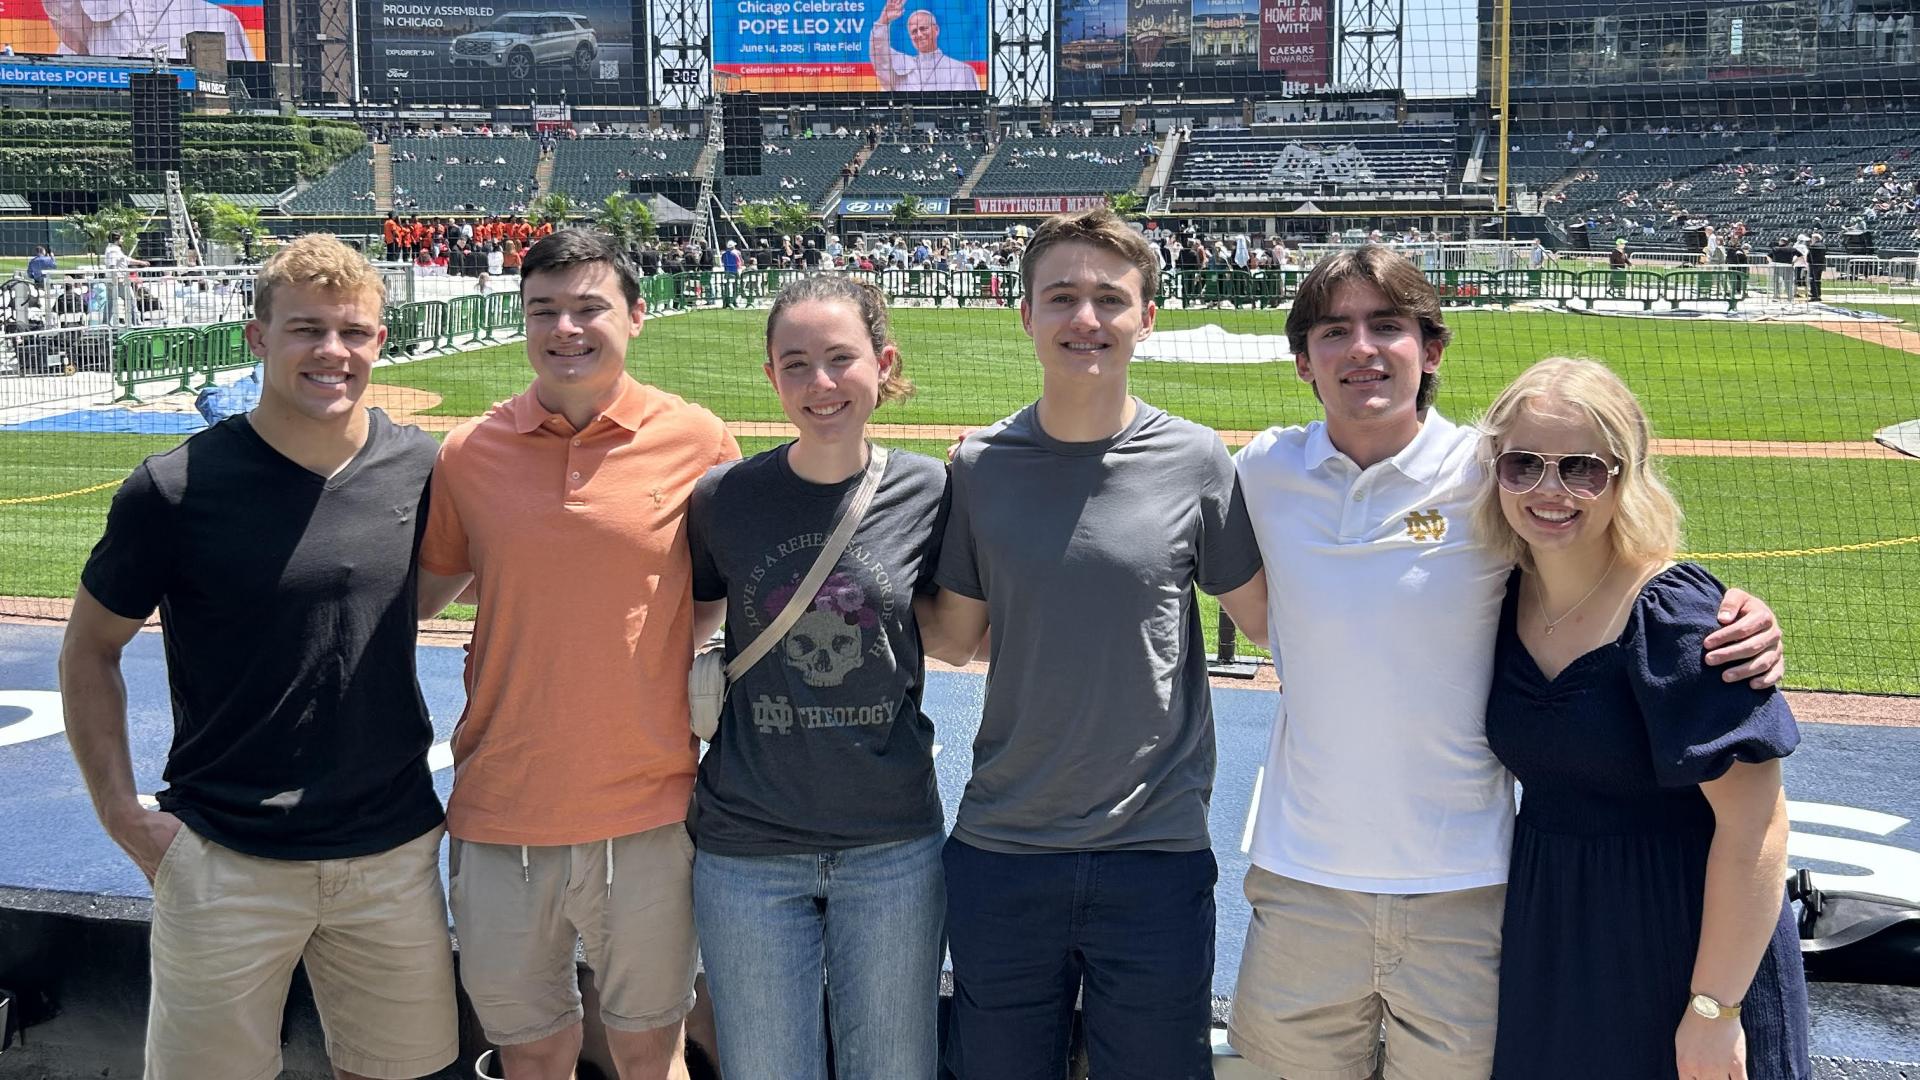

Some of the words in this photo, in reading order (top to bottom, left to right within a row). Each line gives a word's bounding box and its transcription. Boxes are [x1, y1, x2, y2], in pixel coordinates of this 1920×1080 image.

[383, 4, 432, 15] PROUDLY
[433, 6, 494, 17] ASSEMBLED
[737, 0, 791, 15] Chicago
[793, 0, 865, 13] Celebrates
[383, 17, 395, 26] IN
[1264, 8, 1297, 24] HOME
[1299, 7, 1322, 22] RUN
[738, 19, 789, 34] POPE
[793, 18, 830, 34] LEO
[833, 18, 865, 34] XIV
[1277, 23, 1310, 34] WITH
[740, 43, 764, 53] June
[780, 43, 805, 54] 2025
[813, 42, 837, 52] Rate
[838, 41, 862, 52] Field
[1269, 46, 1315, 55] CAESARS
[65, 70, 107, 83] POPE
[110, 72, 130, 84] LE
[386, 67, 409, 78] Ford
[672, 70, 698, 83] 2:02
[740, 65, 786, 74] Celebration
[796, 66, 822, 75] Prayer
[833, 65, 856, 74] Music
[1281, 81, 1311, 98] Lite
[1314, 82, 1374, 95] LANDING
[874, 201, 942, 212] HYDAI
[978, 199, 1062, 213] WHITTINGHAM
[776, 532, 872, 566] REHESAL
[764, 554, 779, 568] A
[750, 564, 766, 583] IS
[868, 562, 894, 598] FOR
[743, 583, 761, 628] LOVE
[797, 700, 895, 729] THEOLOGY
